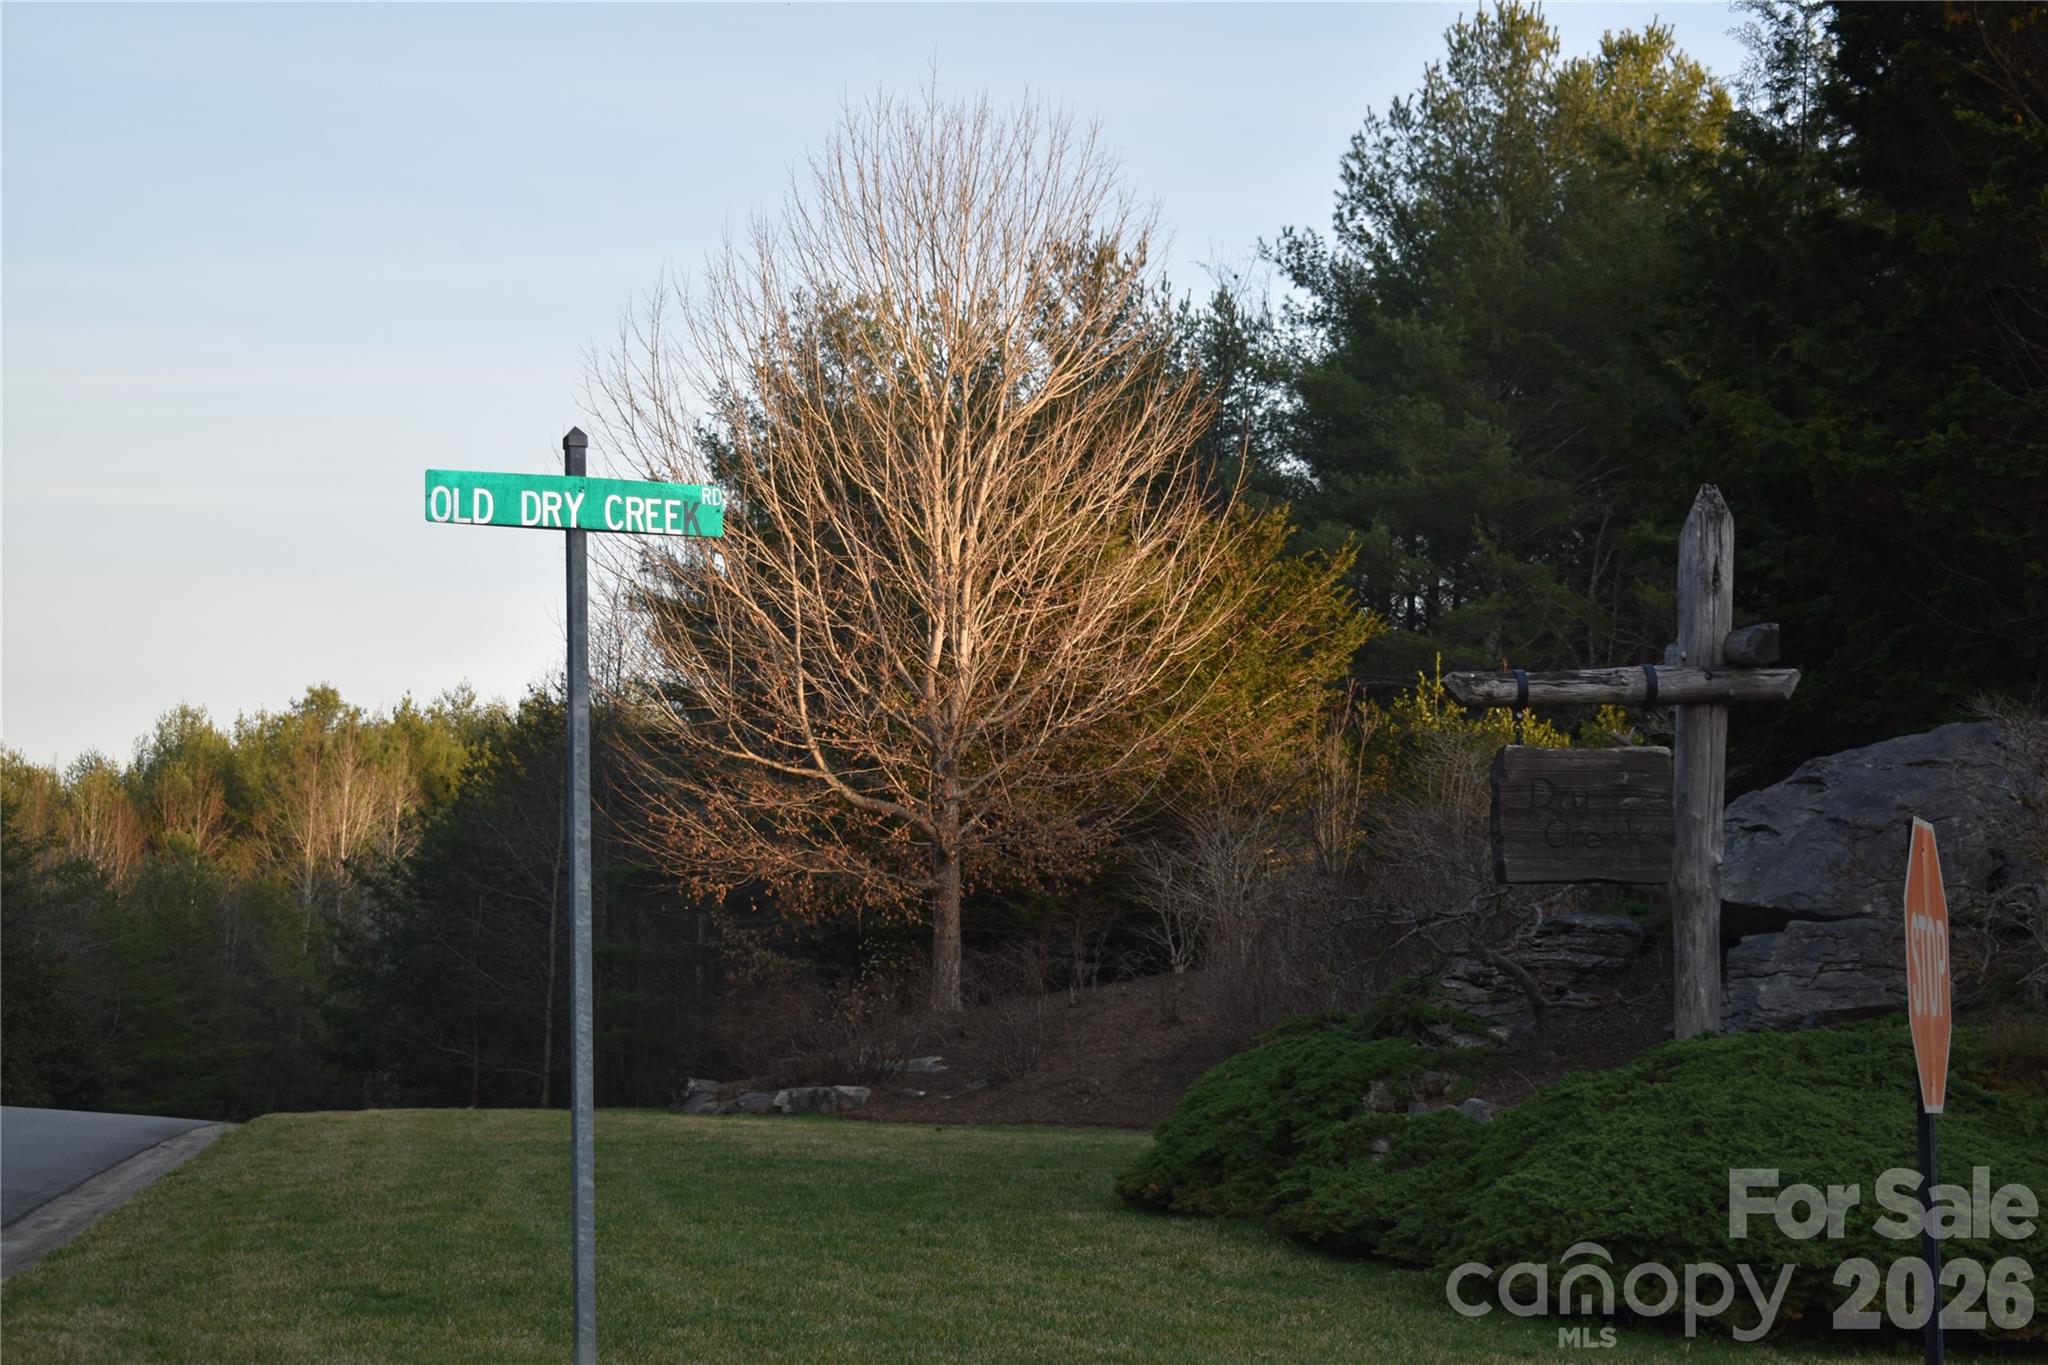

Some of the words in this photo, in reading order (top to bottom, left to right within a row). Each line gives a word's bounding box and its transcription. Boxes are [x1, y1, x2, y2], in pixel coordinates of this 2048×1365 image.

[430, 485, 494, 524] OLD
[521, 490, 585, 528] DRY
[604, 494, 700, 537] CREEK
[701, 486, 722, 506] RD
[1911, 911, 1946, 1018] STOP
